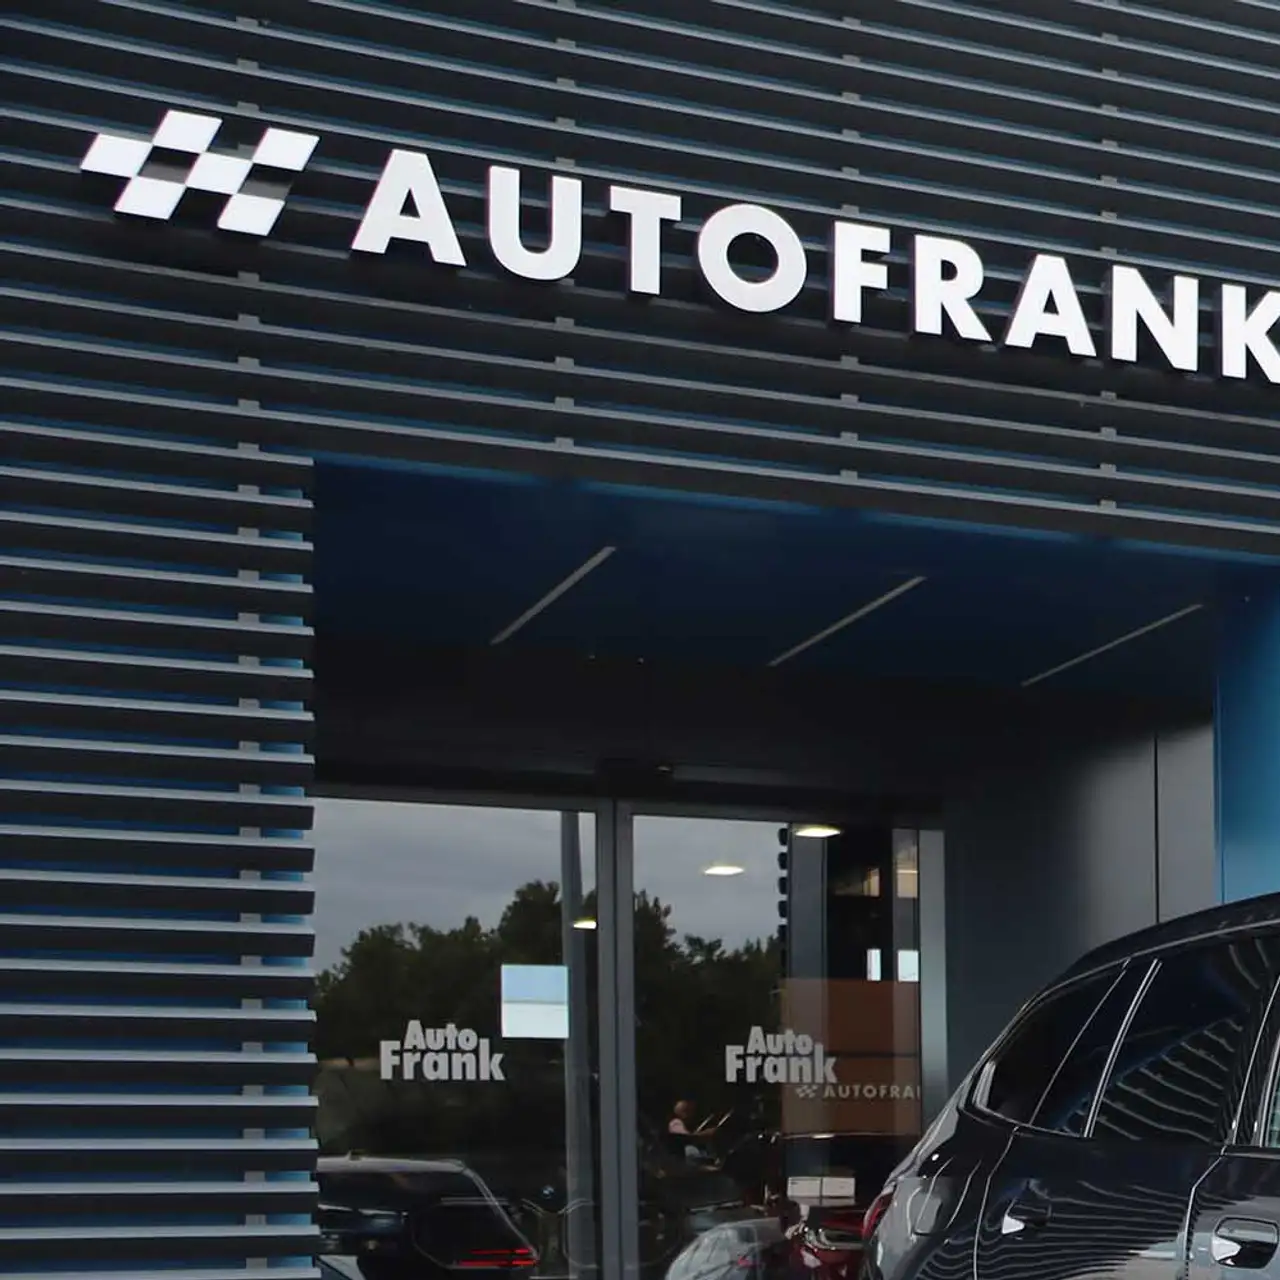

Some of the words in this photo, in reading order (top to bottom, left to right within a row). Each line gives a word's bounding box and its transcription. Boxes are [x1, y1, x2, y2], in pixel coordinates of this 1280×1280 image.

[403, 1019, 478, 1051] Auto
[746, 1026, 814, 1055] Auto
[380, 1038, 505, 1081] Frank
[725, 1043, 838, 1084] Frank
[823, 1084, 920, 1099] AUTOFRA
